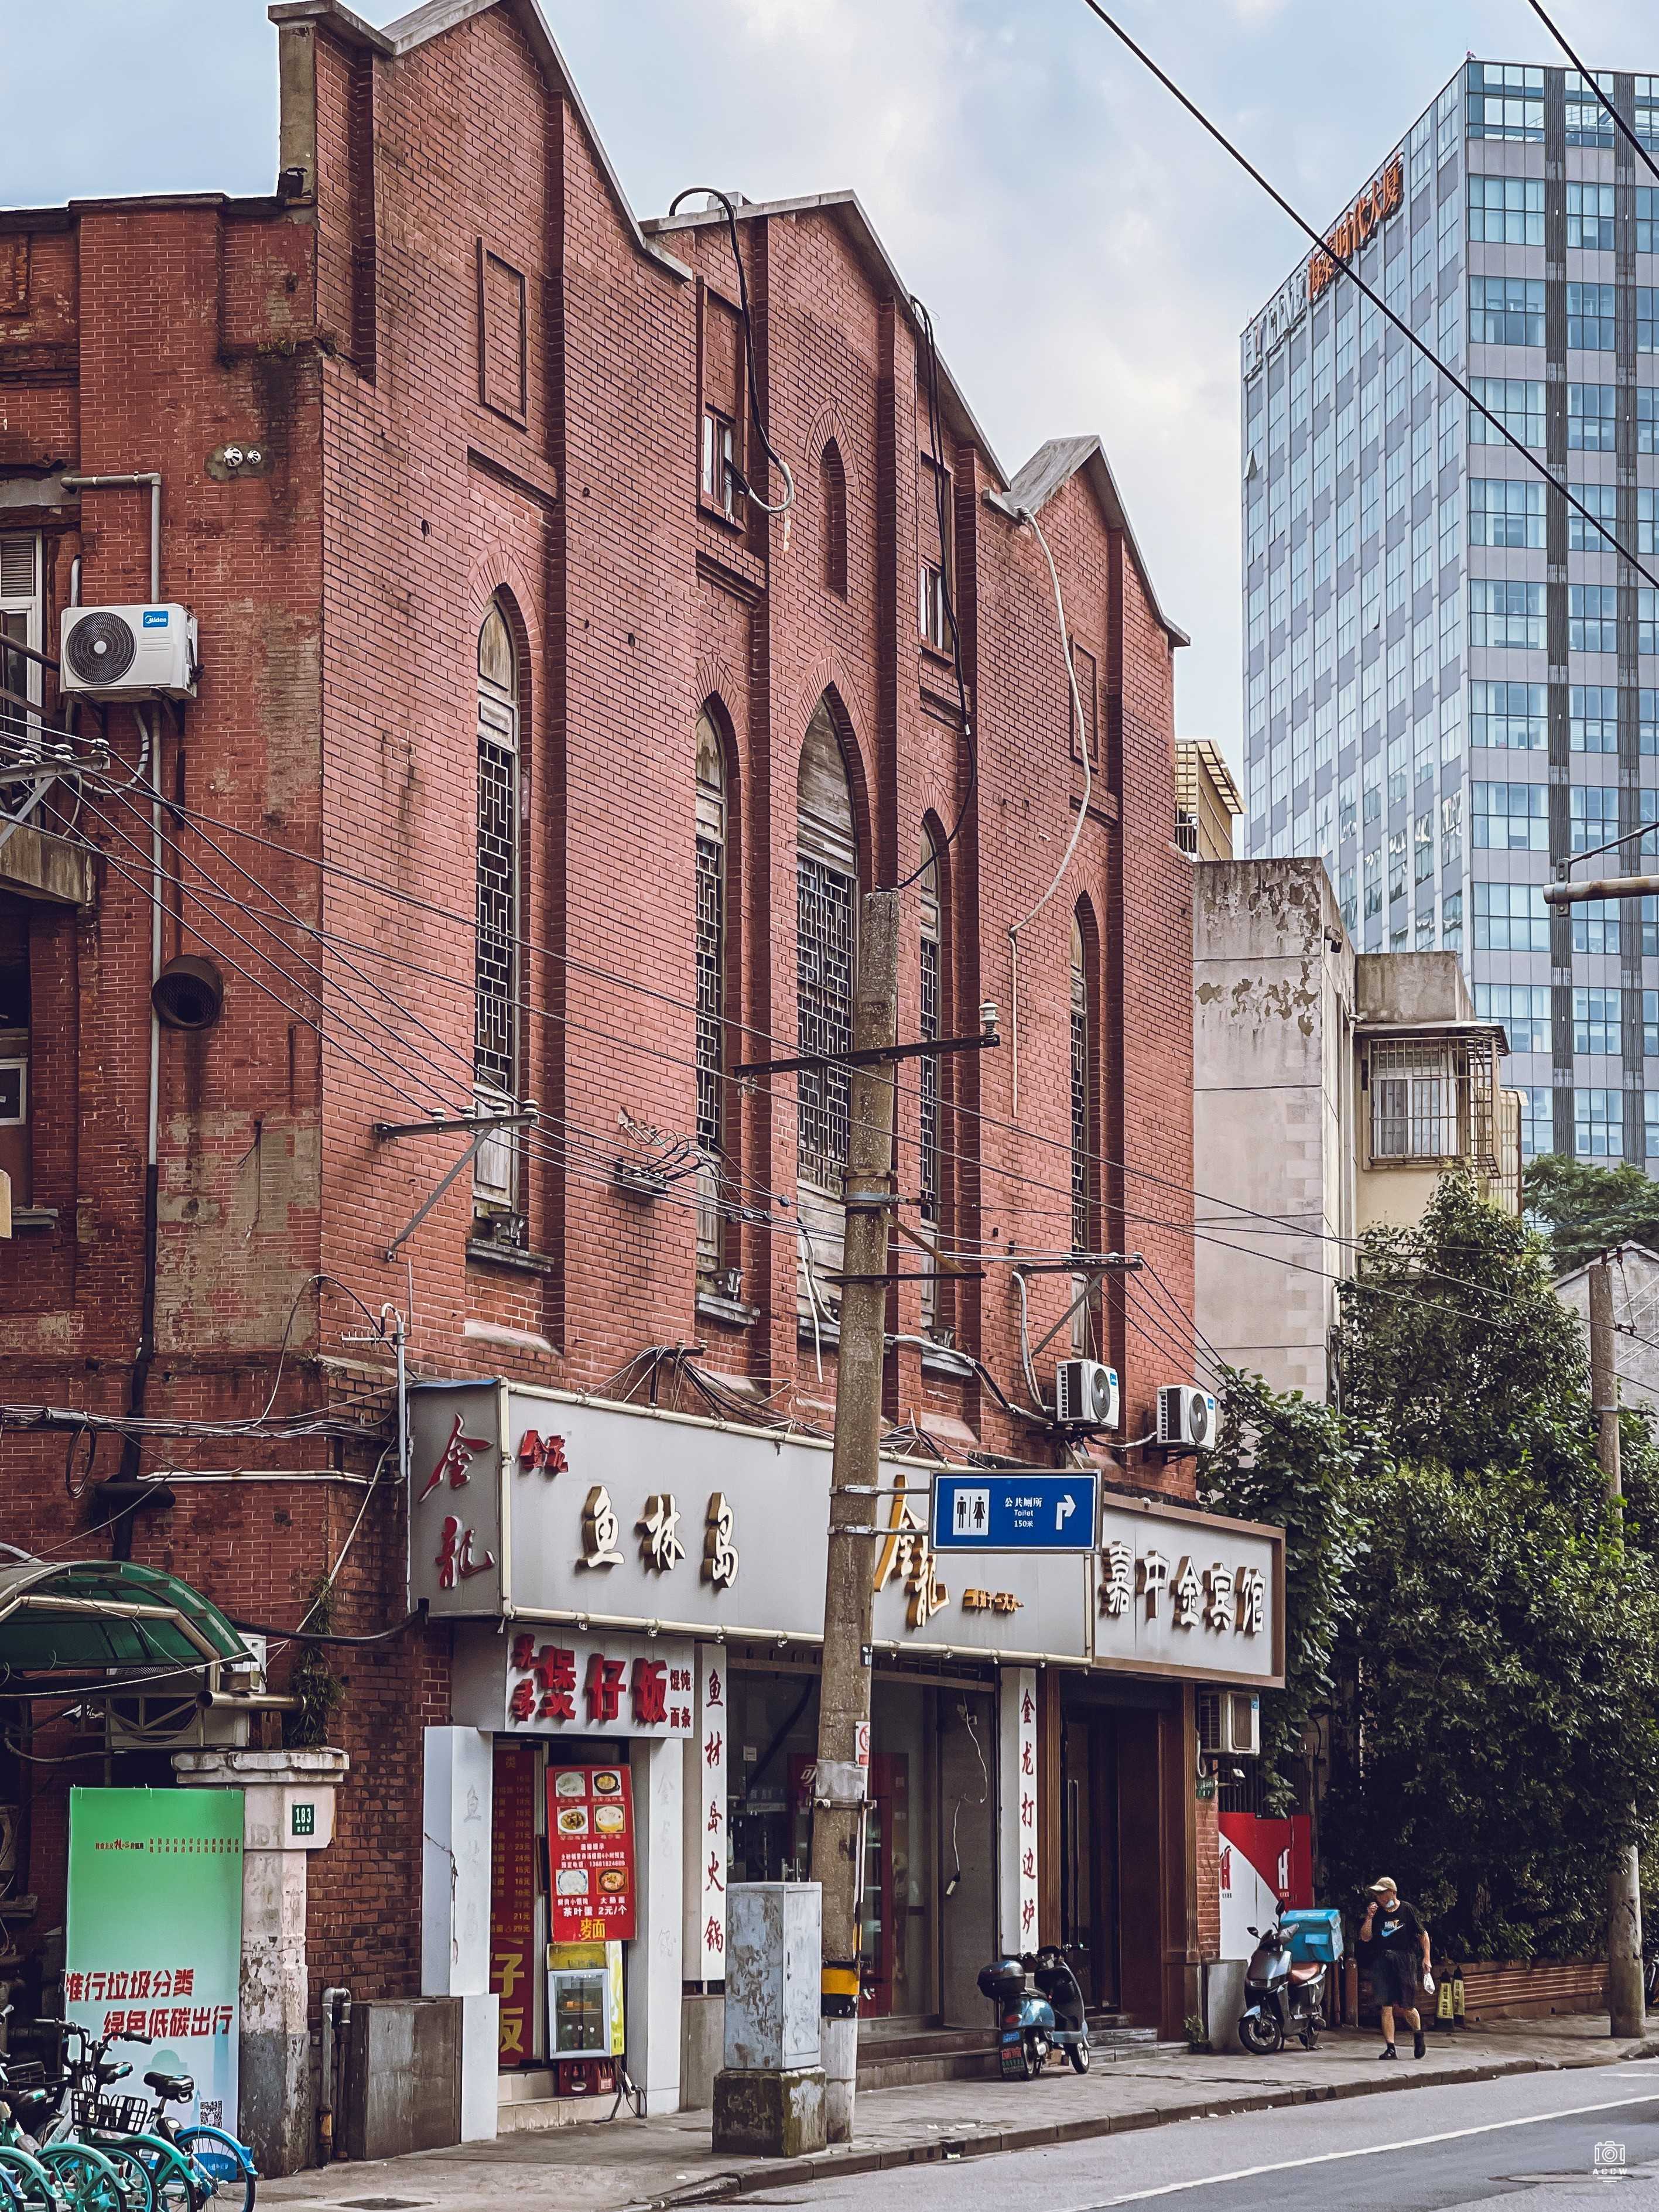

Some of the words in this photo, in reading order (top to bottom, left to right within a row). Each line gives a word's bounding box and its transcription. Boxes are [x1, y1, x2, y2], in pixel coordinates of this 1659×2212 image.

[145, 615, 167, 624] Midea
[1005, 1497, 1042, 1507] 公共厕所
[1014, 1520, 1034, 1528] 150米
[1100, 1541, 1266, 1633] 嘉中金宾馆
[537, 1645, 668, 1723] 煲仔饭
[669, 1669, 690, 1691] 馄饨
[669, 1707, 690, 1729] 面条
[296, 1807, 312, 1824] 183
[563, 1906, 593, 1917] 茶叶蛋
[598, 1905, 627, 1916] 2元/个
[66, 1968, 194, 2002] 推行垃圾分类
[102, 2005, 233, 2041] 绿色低碳出行
